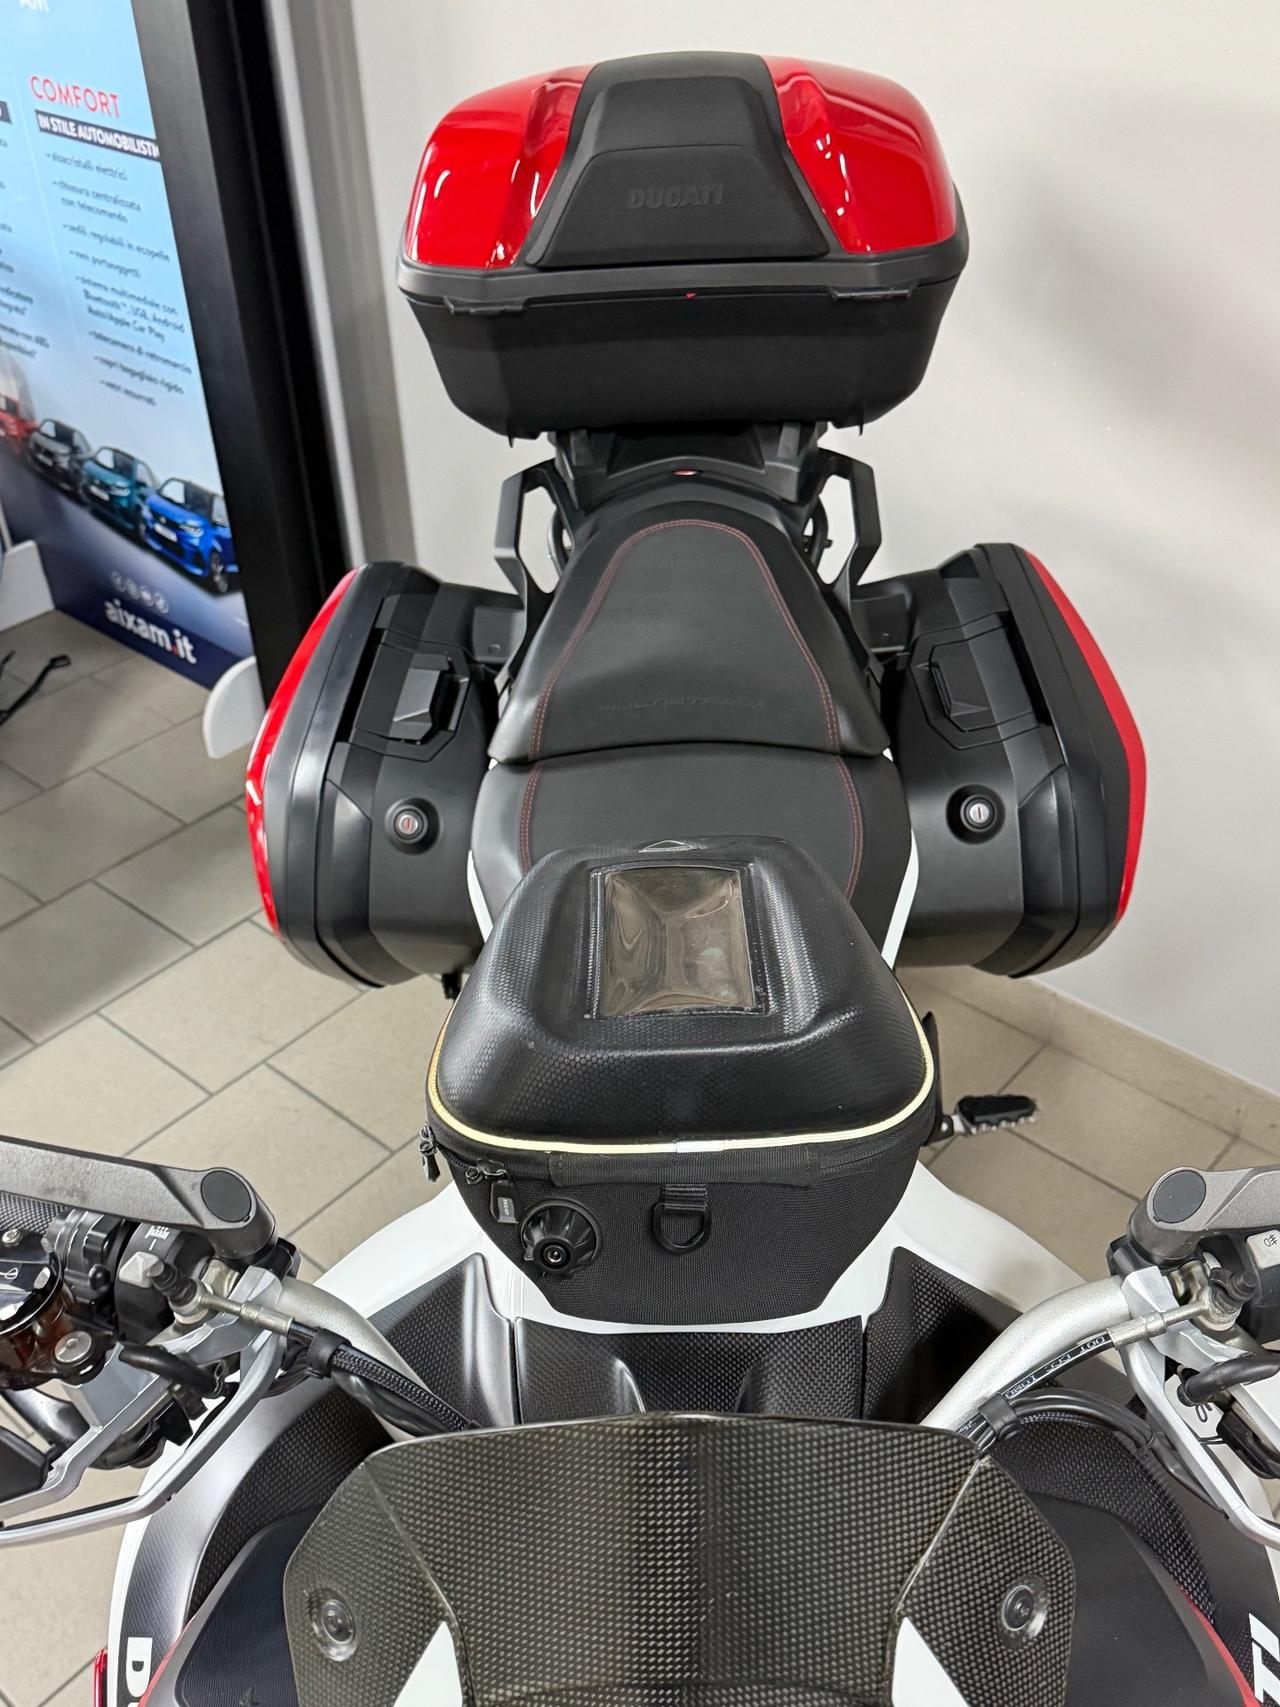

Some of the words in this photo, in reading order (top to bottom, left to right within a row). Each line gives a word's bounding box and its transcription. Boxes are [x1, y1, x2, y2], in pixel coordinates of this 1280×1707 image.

[30, 75, 121, 118] COMFORT
[38, 113, 51, 130] IN
[50, 116, 77, 138] STILE
[624, 181, 725, 210] DUCATI
[104, 598, 197, 665] aixam.it
